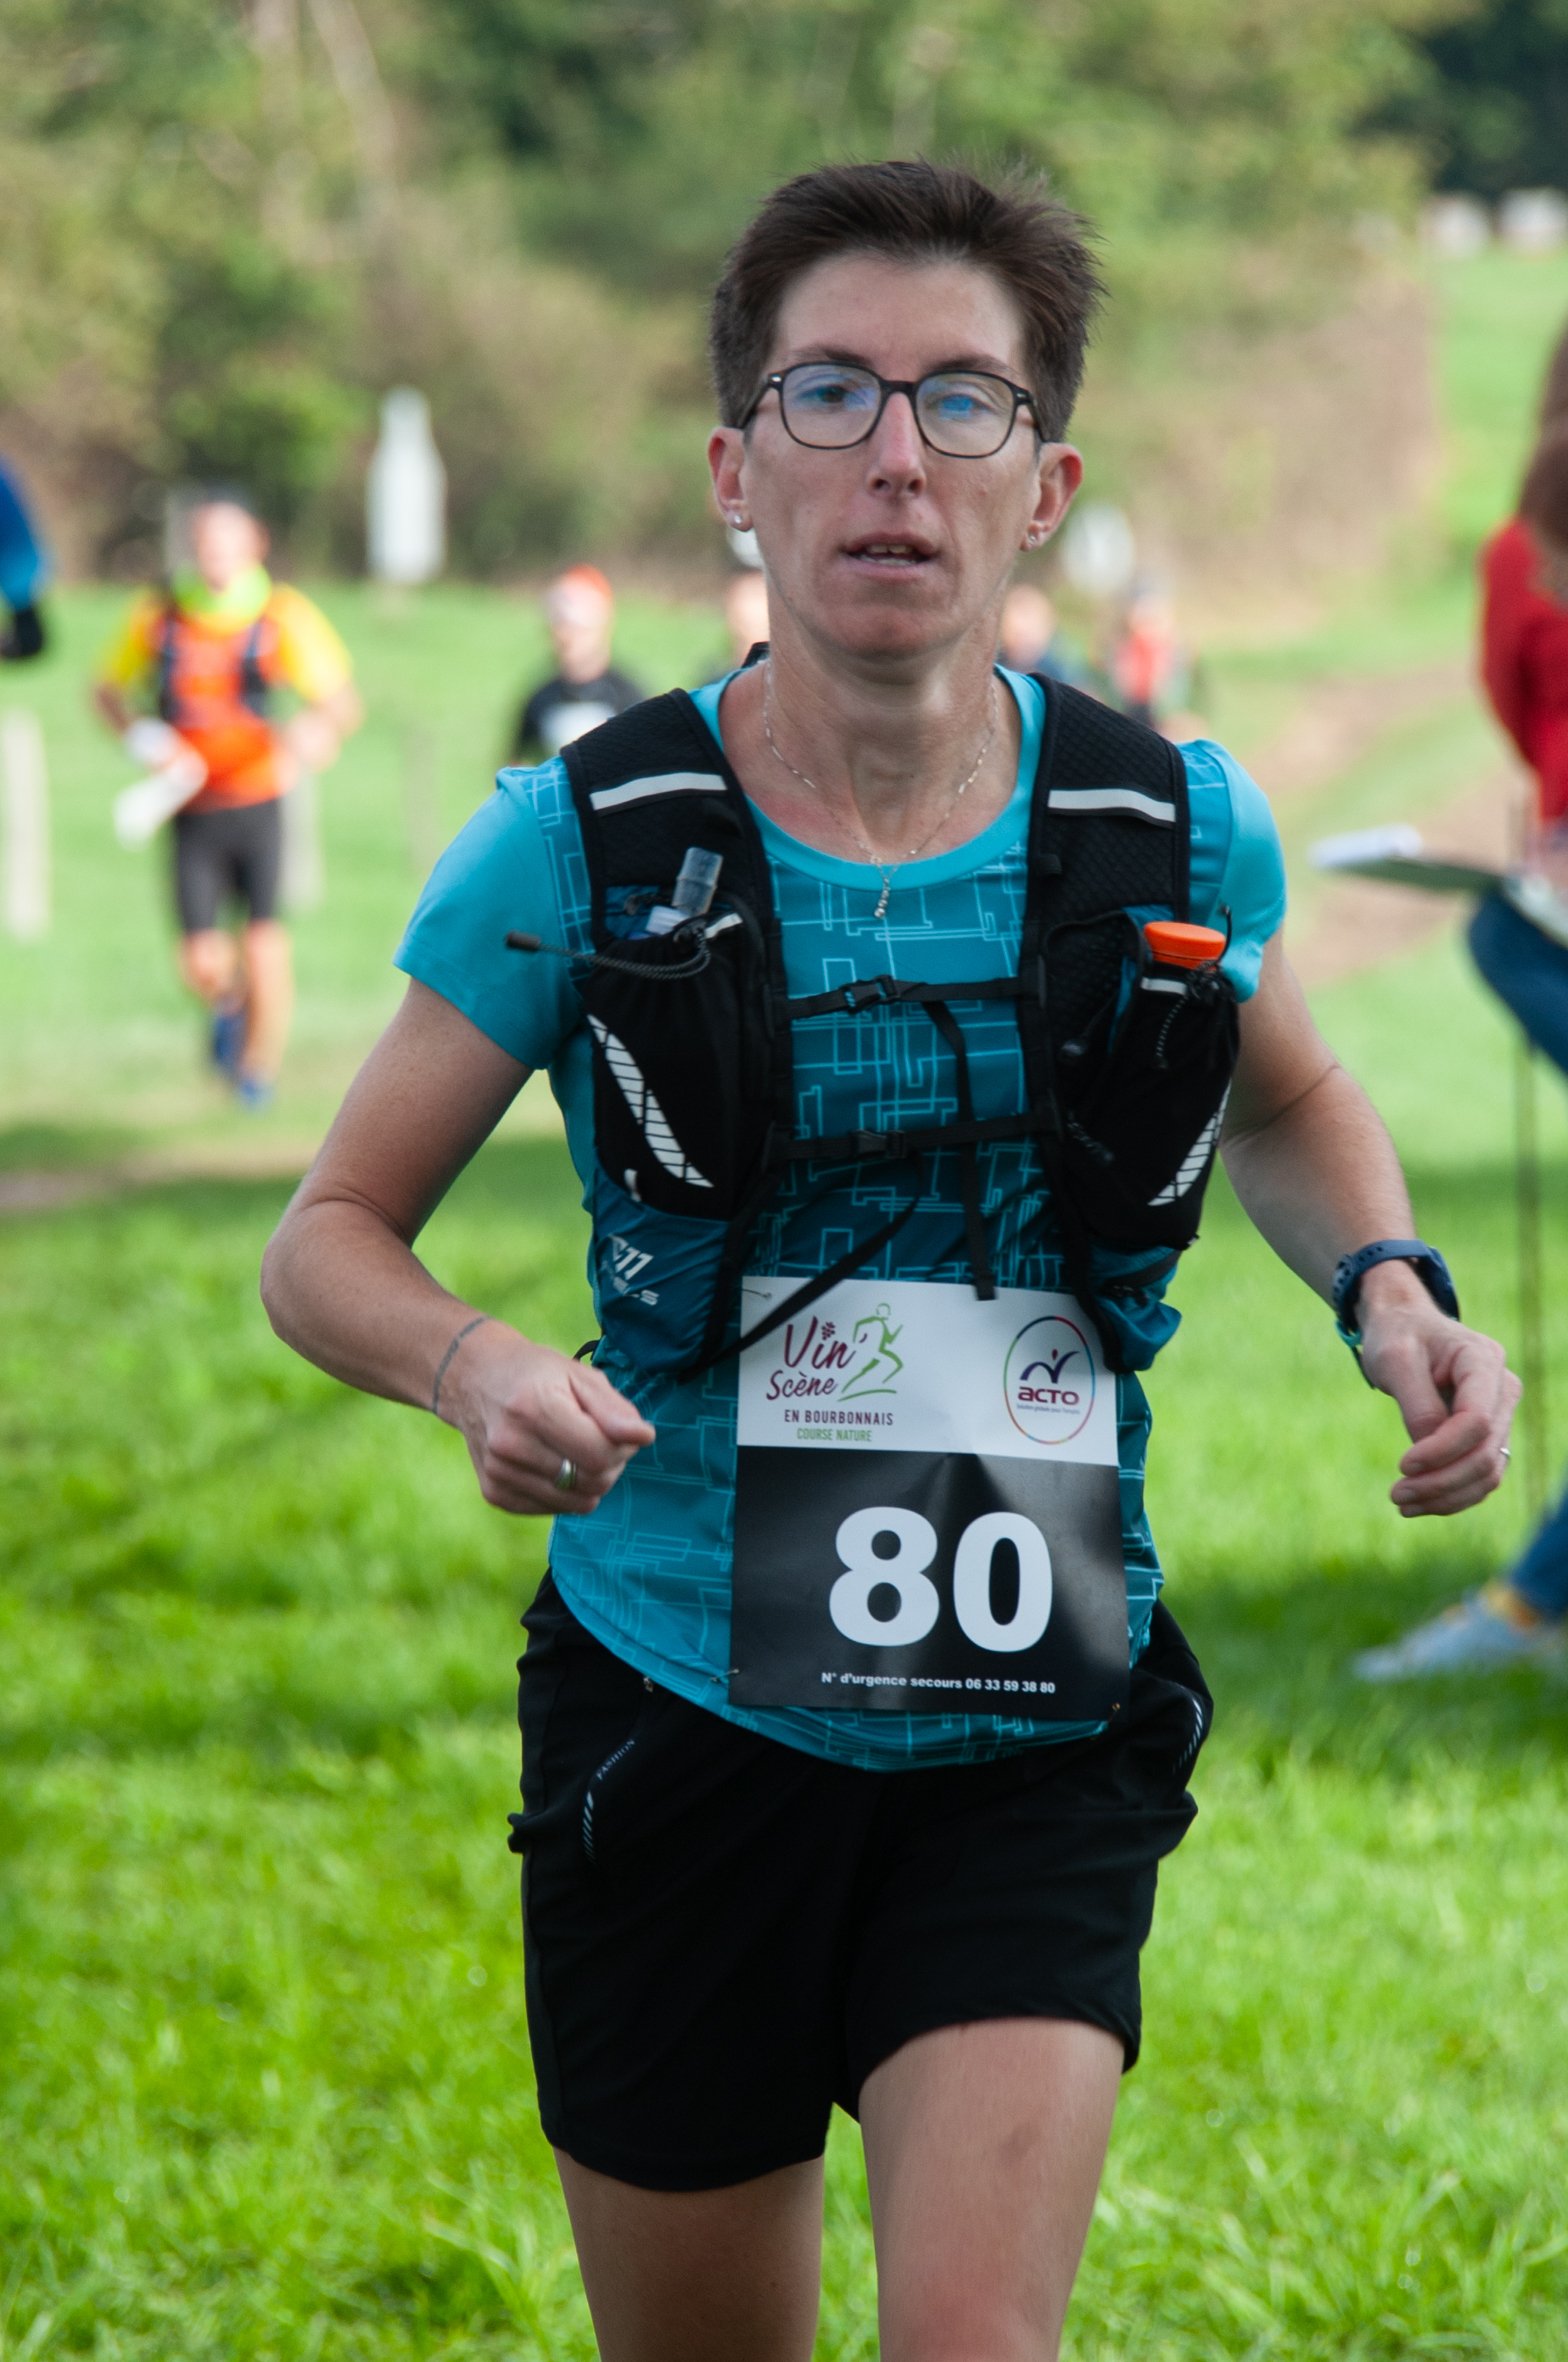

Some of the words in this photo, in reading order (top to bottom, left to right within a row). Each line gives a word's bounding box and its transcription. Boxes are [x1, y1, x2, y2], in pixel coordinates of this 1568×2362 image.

[784, 1315, 856, 1369] Vin
[766, 1370, 838, 1400] Scène
[784, 1409, 800, 1423] EN
[805, 1410, 894, 1426] BOURBONNAIS
[797, 1428, 833, 1441] COURSE
[836, 1429, 872, 1442] NATURE
[829, 1506, 1053, 1653] 80
[840, 1673, 907, 1688] d'urgence
[910, 1677, 962, 1690] secours
[965, 1678, 982, 1690] 06
[984, 1679, 1000, 1691] 33
[1003, 1680, 1019, 1692] 59
[1022, 1681, 1037, 1693] 38
[1040, 1682, 1056, 1694] 80
